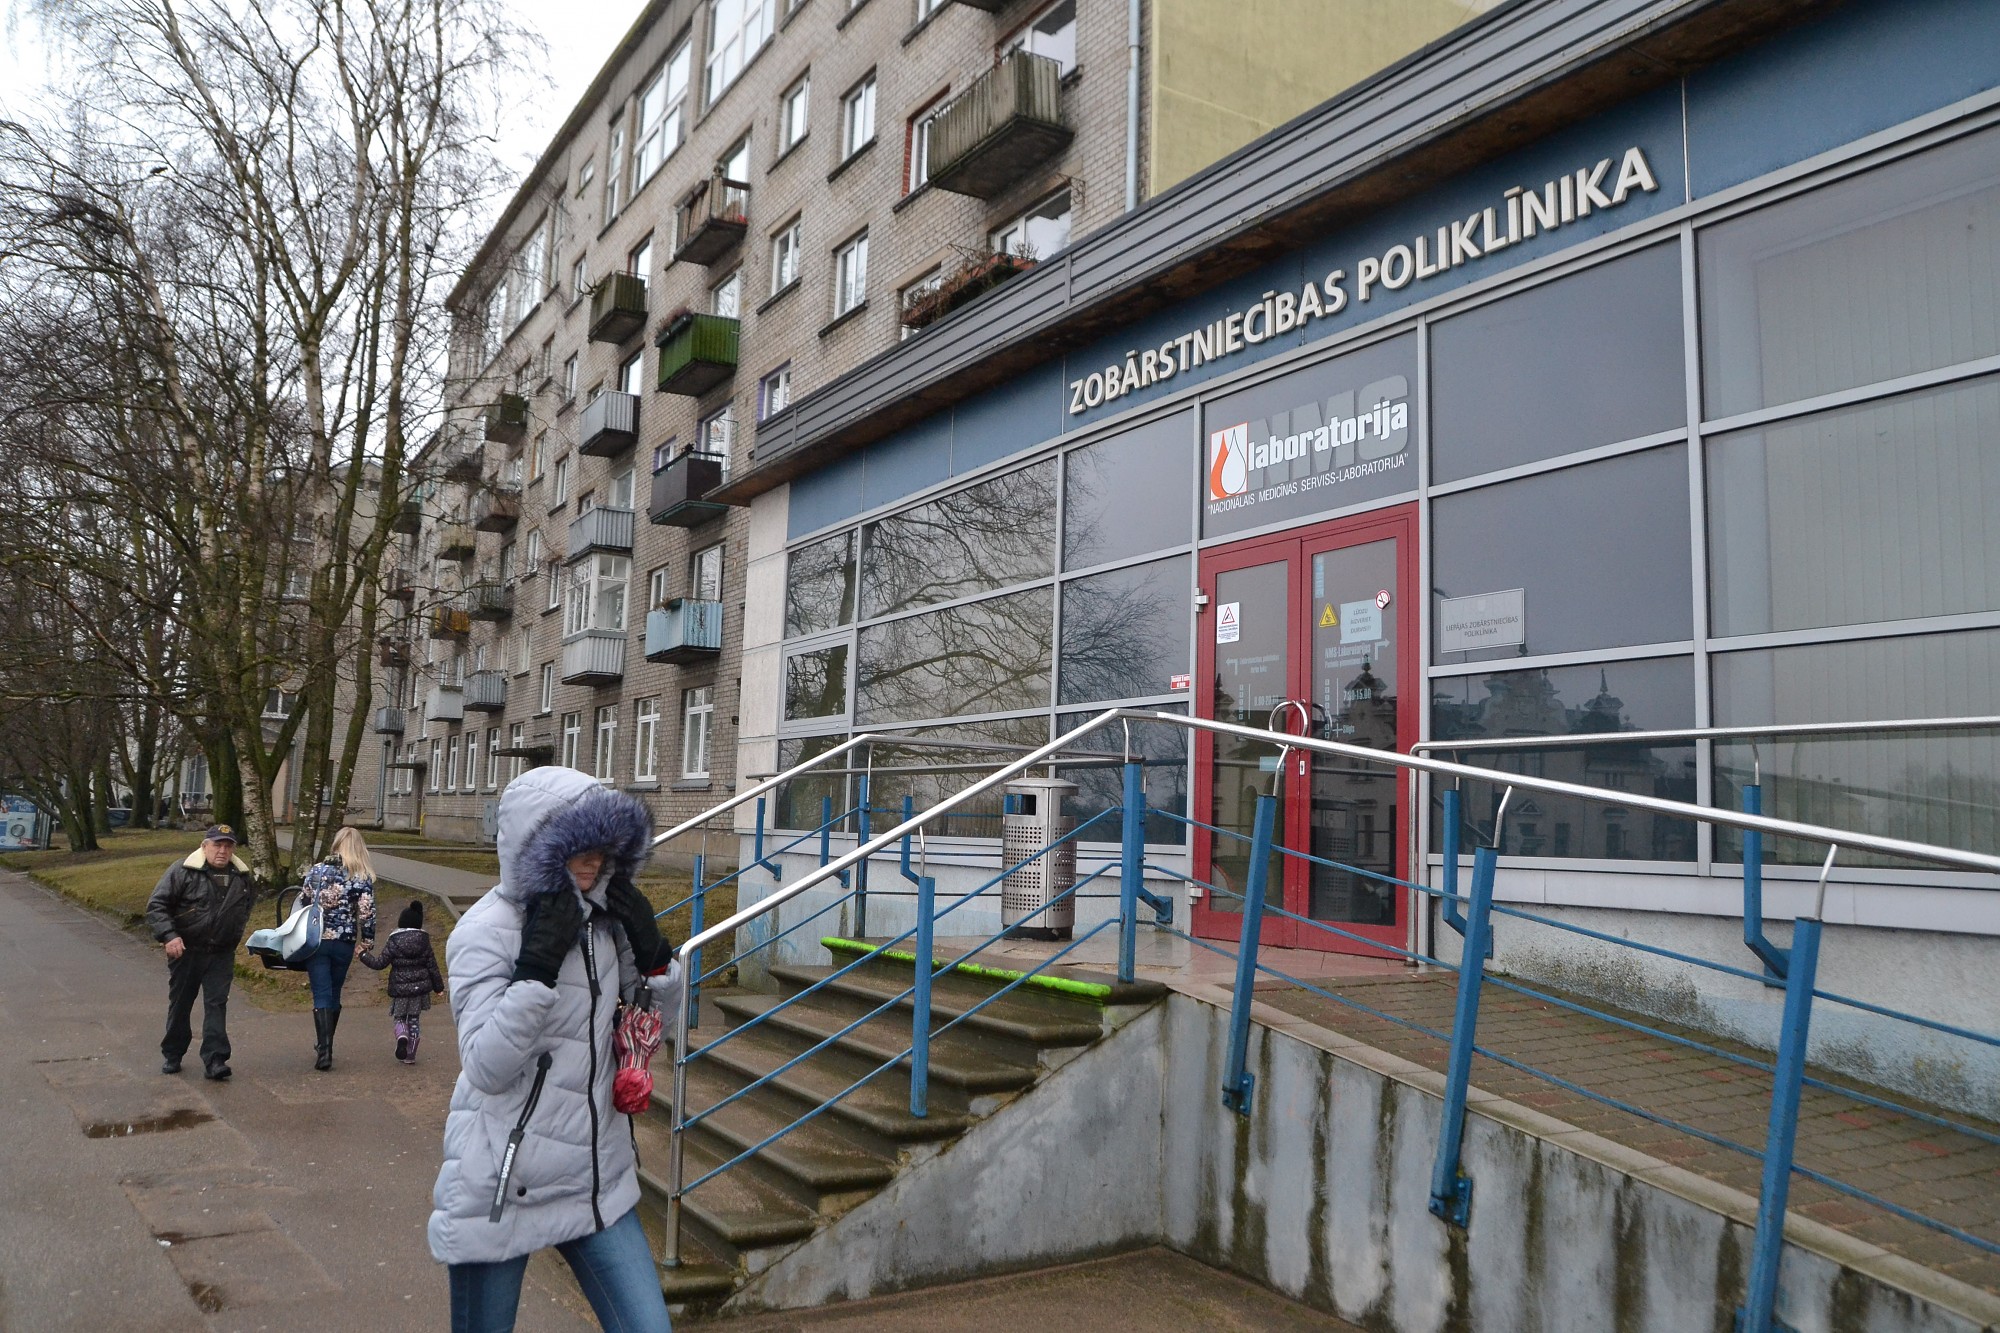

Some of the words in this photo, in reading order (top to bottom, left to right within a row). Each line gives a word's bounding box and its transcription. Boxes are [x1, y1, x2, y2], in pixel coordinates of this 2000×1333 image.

[1069, 269, 1348, 415] ZOBĀRSTNIECĪBAS
[1358, 146, 1658, 301] POLIKLĪNIKA
[1248, 374, 1408, 491] NMS
[1248, 400, 1408, 472] laboratorija
[1258, 481, 1298, 503] MEDICĪNAS
[1446, 621, 1468, 632] LIEPĀJAS
[1469, 616, 1519, 629] ZOBĀRSTNIECĪBAS
[1464, 627, 1498, 637] POLIKLĪNIKA
